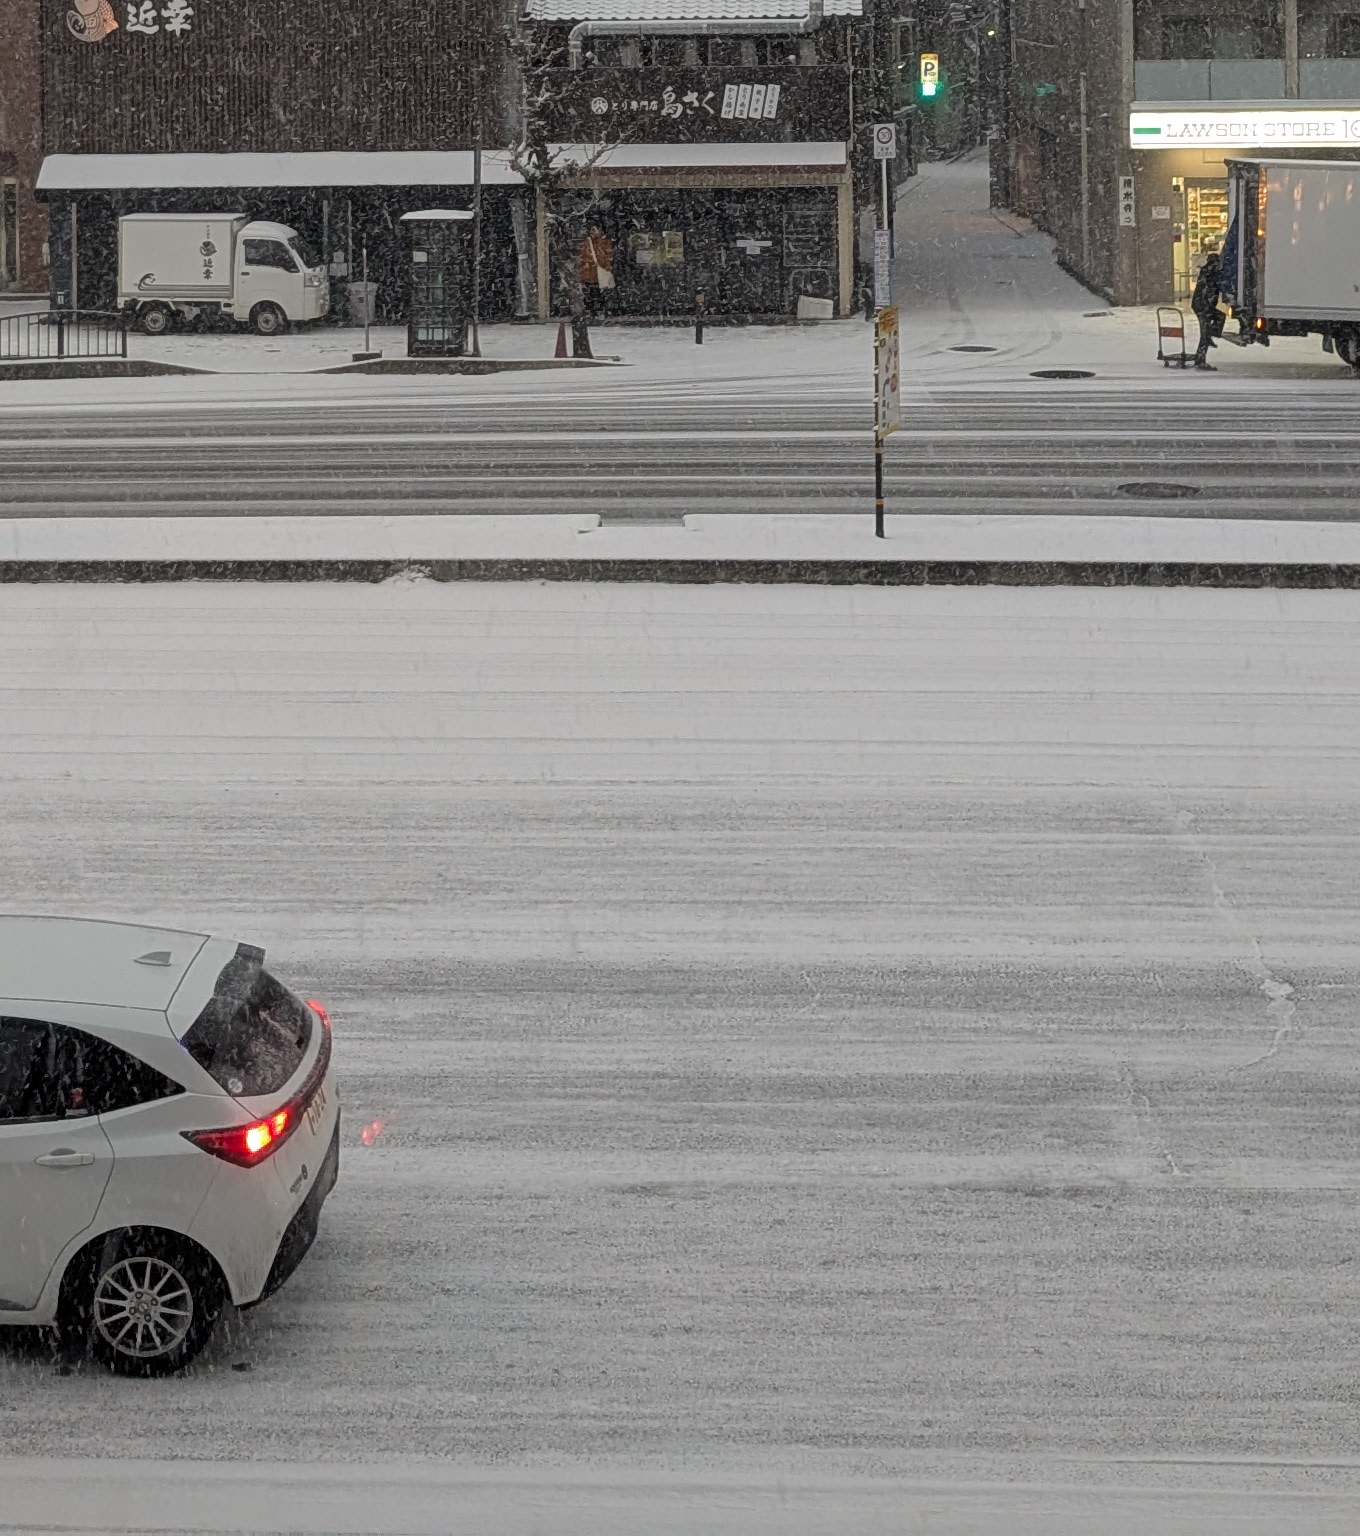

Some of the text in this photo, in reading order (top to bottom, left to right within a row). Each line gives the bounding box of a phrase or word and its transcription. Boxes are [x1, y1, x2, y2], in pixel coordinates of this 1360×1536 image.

[924, 61, 936, 78] P
[1167, 123, 1257, 138] LAWSON
[1264, 123, 1335, 137] STORE
